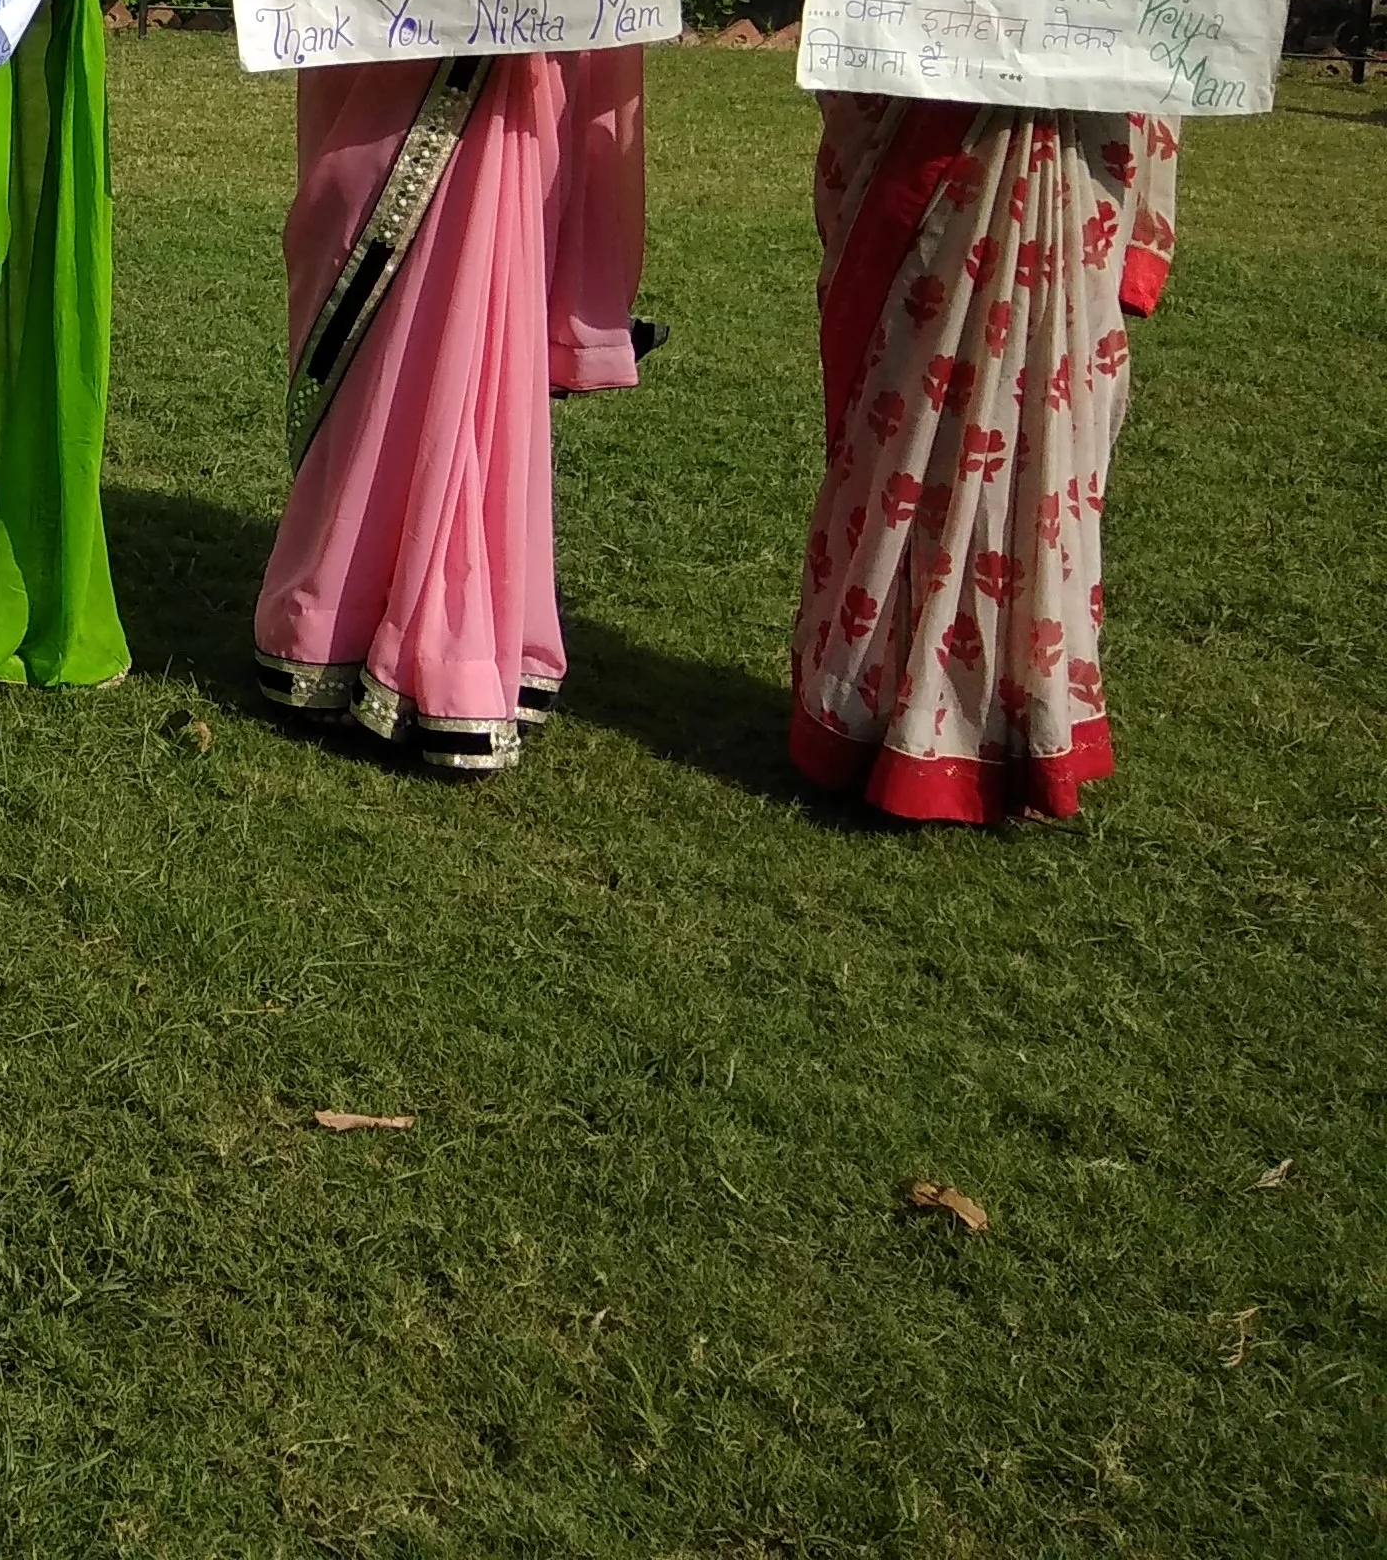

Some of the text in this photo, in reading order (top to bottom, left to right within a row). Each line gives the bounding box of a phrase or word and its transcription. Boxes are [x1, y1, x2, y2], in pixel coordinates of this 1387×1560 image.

[255, 3, 355, 66] Thank
[806, 26, 907, 77] सिखाता
[1042, 5, 1124, 56] लेकर
[1159, 54, 1247, 109] Mam
